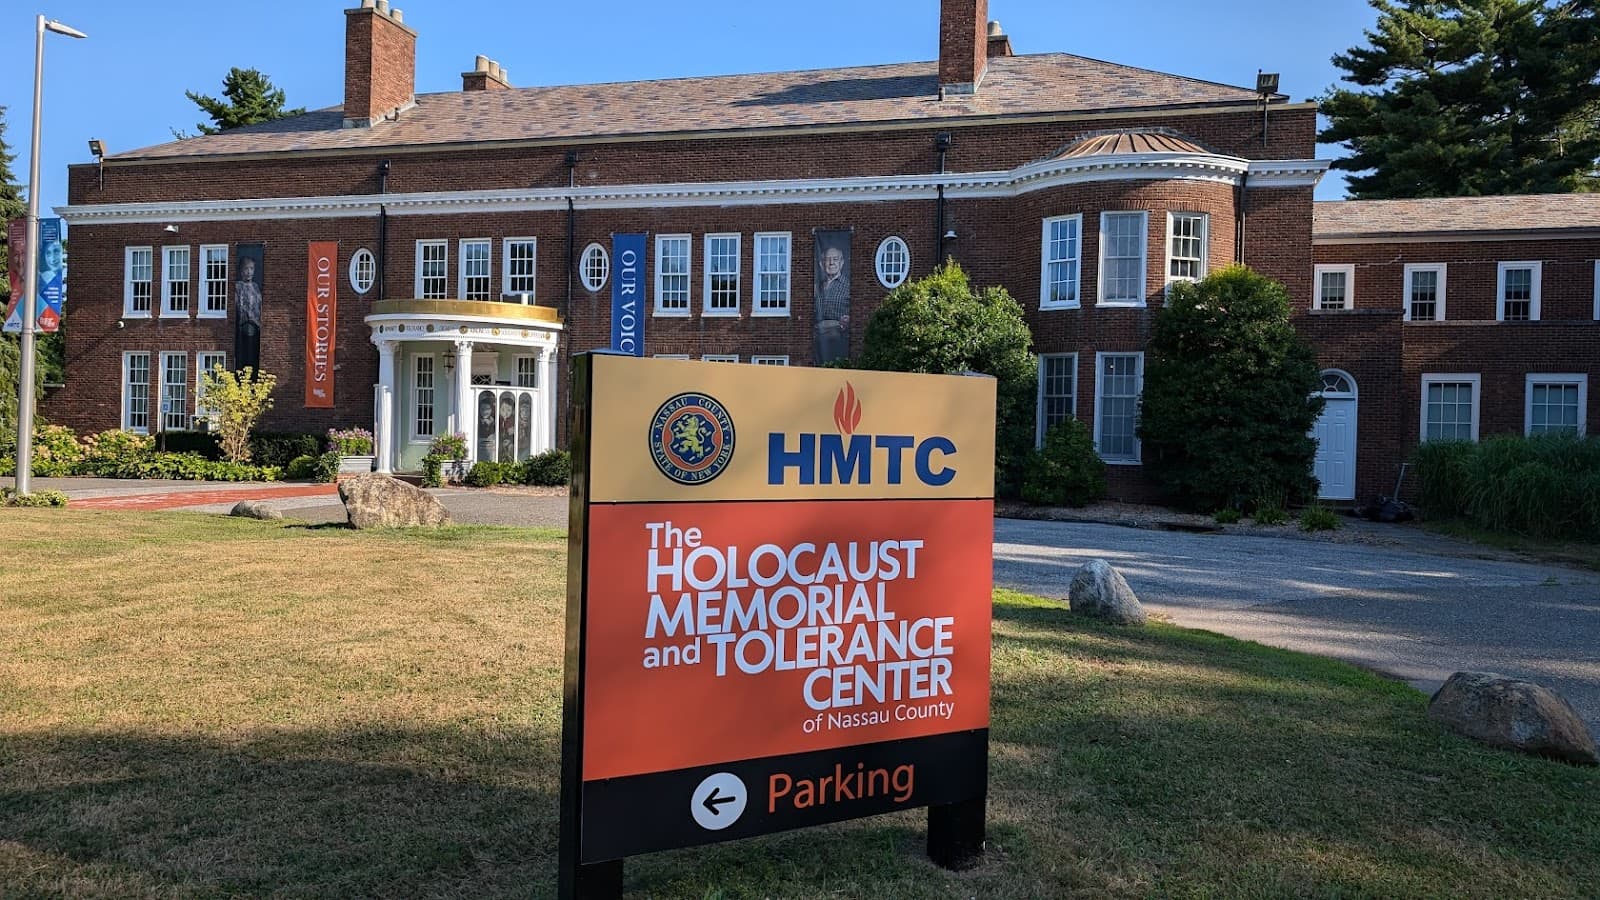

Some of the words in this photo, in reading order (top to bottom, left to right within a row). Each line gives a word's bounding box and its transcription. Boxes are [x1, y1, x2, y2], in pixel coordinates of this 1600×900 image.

[316, 256, 331, 298] OUR
[621, 249, 636, 295] OUR
[313, 303, 330, 382] STORIES
[655, 397, 688, 430] NASSAU
[698, 398, 731, 431] COUNTY
[654, 441, 673, 471] STATE
[674, 469, 688, 479] OF
[691, 467, 712, 480] NEW
[714, 443, 731, 469] YORK
[767, 432, 957, 486] HMTC
[645, 521, 702, 549] The
[646, 539, 924, 593] HOLOCAUST
[644, 581, 895, 639] MEMORIAL
[643, 636, 701, 668] and
[707, 617, 954, 677] TOLERANCE
[802, 657, 953, 711] CENTER
[802, 714, 823, 733] of
[827, 709, 889, 730] Nassau
[895, 701, 955, 721] County
[768, 762, 915, 813] Parking
